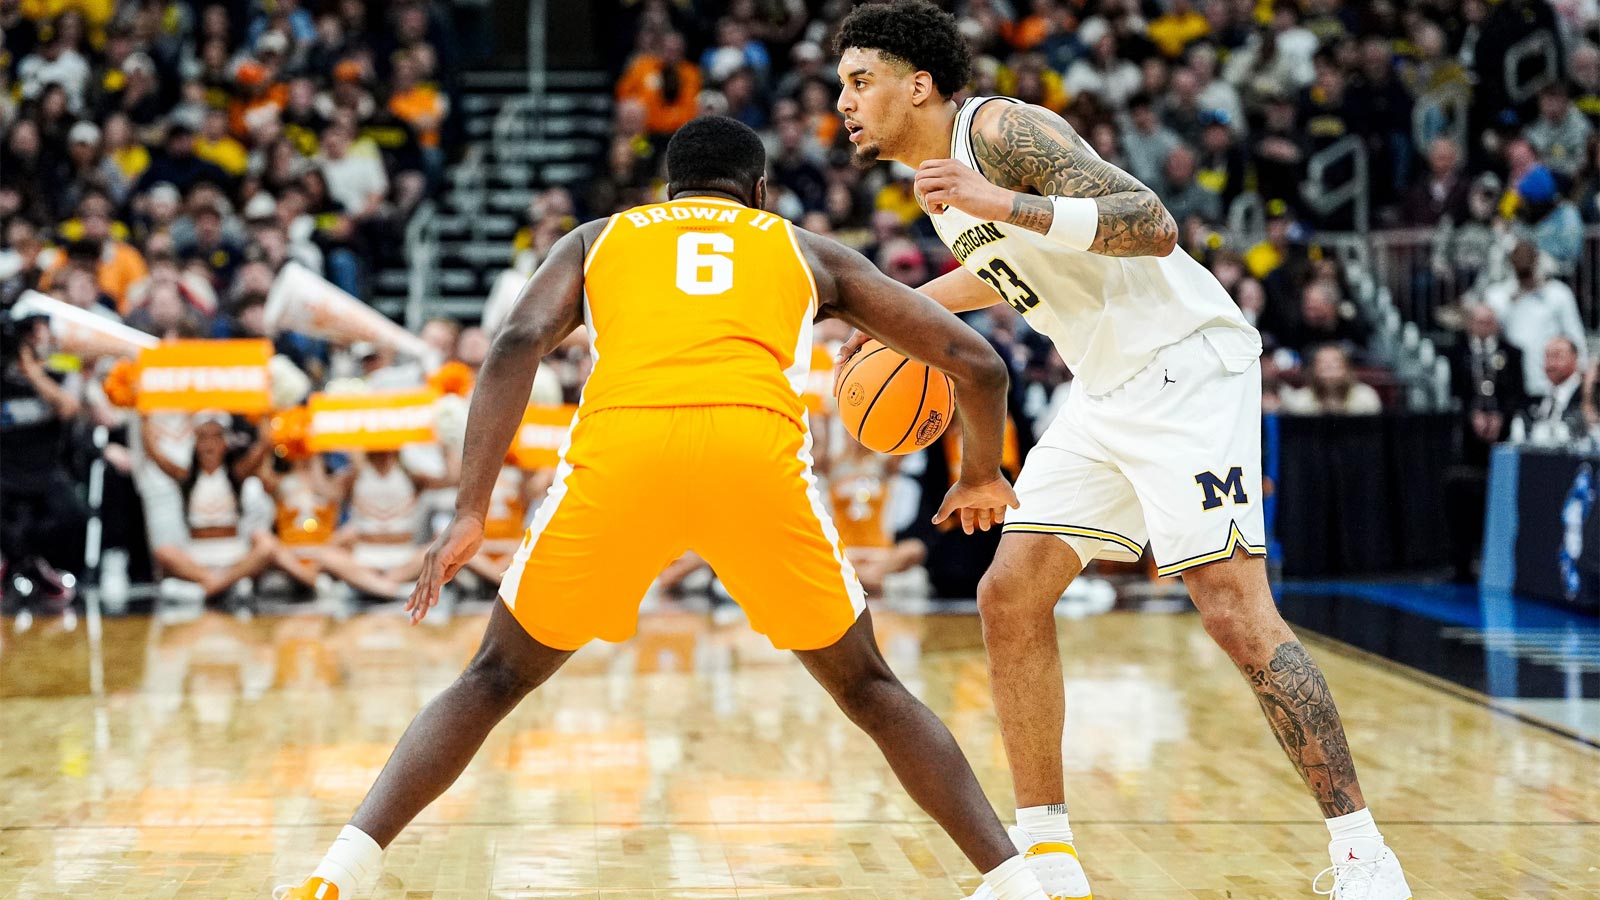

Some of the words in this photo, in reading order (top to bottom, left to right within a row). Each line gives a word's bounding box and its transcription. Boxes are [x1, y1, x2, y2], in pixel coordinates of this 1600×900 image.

[625, 206, 741, 228] BROWN
[749, 212, 779, 231] II
[676, 232, 734, 295] 6
[952, 221, 1006, 263] ICHIGAN
[976, 257, 1041, 315] 23
[1194, 466, 1249, 511] M
